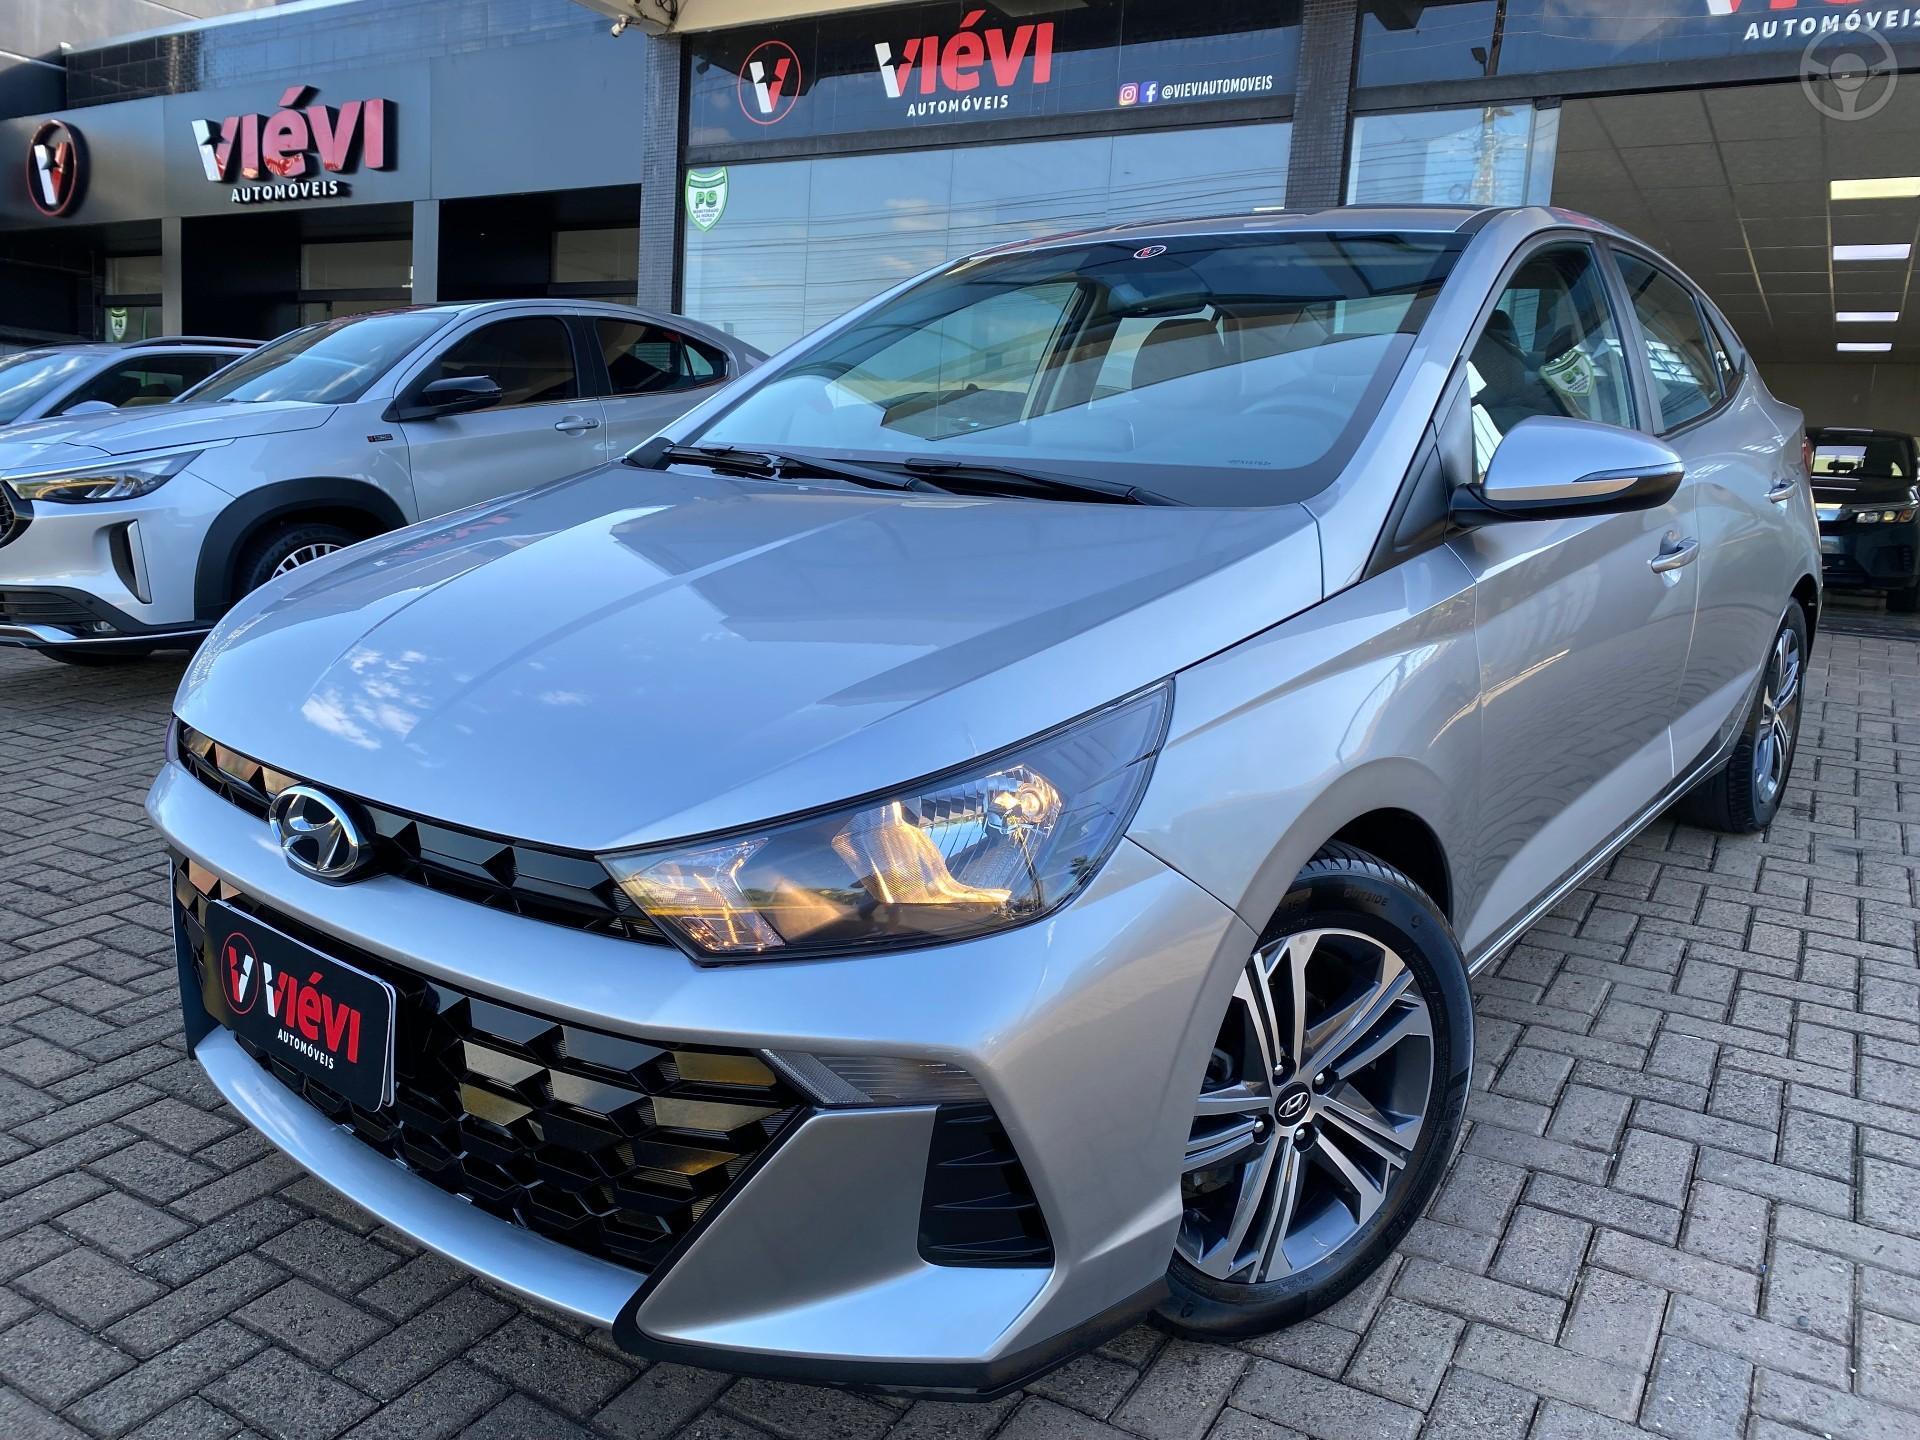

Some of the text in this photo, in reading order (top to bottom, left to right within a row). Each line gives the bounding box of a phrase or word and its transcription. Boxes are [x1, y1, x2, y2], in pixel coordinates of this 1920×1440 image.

[1161, 75, 1273, 99] @VIEVIAUTOMOVEIS
[907, 94, 1009, 117] AUTOMÓVEIS
[231, 178, 338, 203] AUTOMÓVEIS
[277, 1028, 335, 1070] AUTOMÓVEIS
